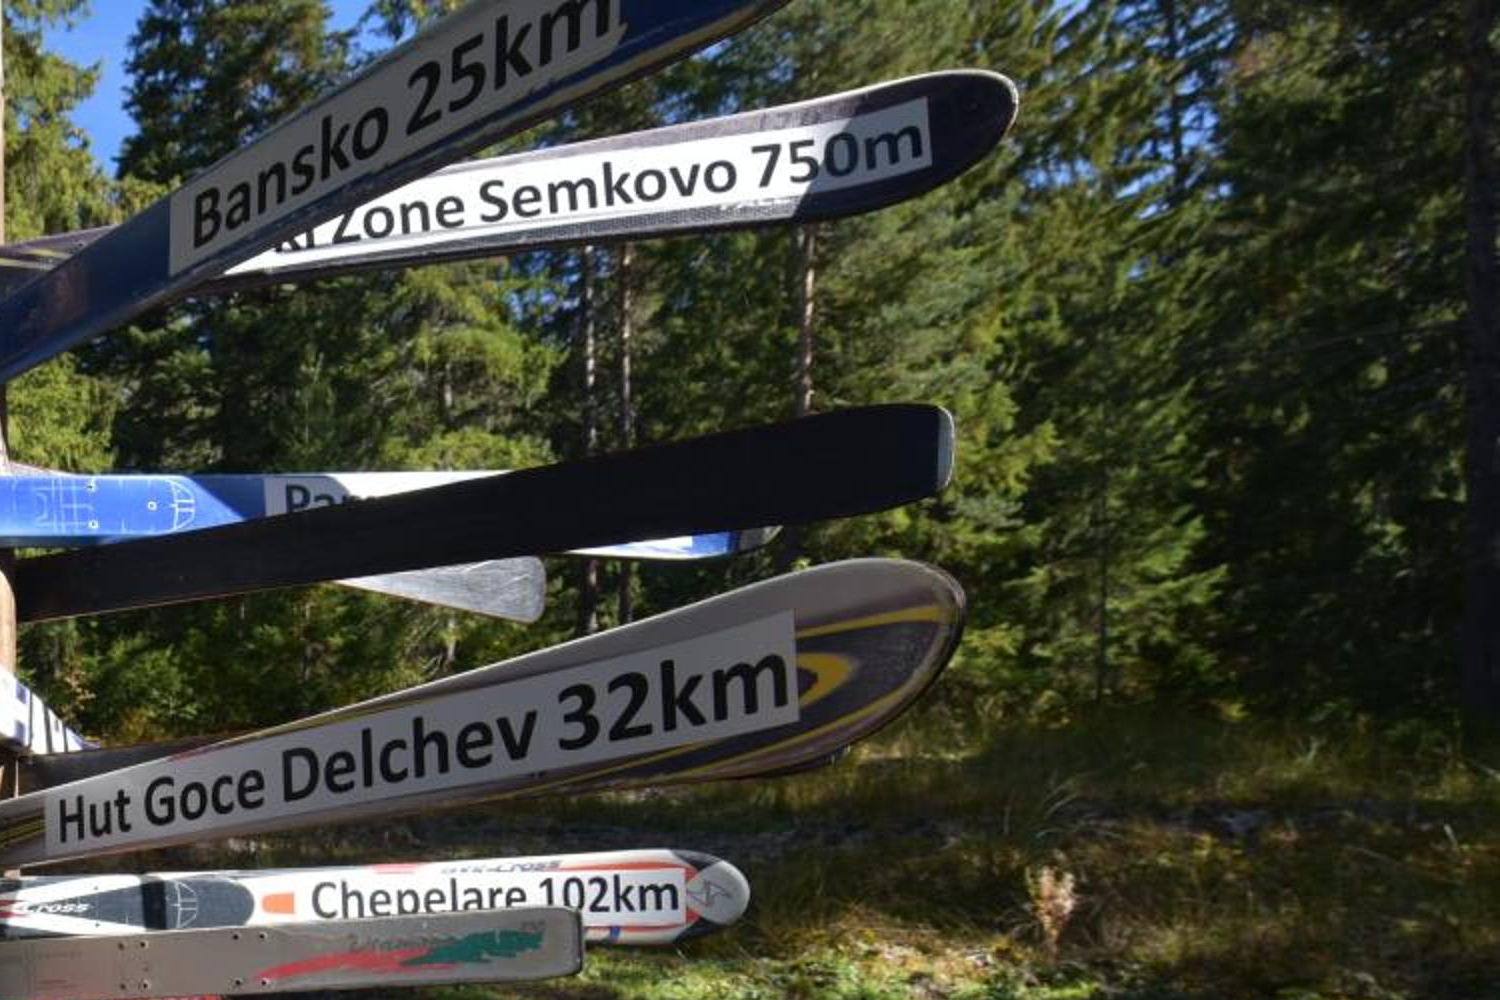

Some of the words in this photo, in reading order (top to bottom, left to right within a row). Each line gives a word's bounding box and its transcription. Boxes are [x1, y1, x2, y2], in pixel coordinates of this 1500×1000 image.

[193, 107, 390, 249] Bansko
[406, 0, 612, 136] 25km
[332, 195, 465, 245] Zone
[478, 158, 737, 224] Semkovo
[751, 123, 923, 188] 750m
[58, 793, 132, 845] Hut
[144, 766, 266, 826] Goce
[281, 711, 537, 800] Delchev
[557, 651, 791, 752] 32km
[311, 878, 527, 918] Chepelare
[538, 873, 680, 914] 102km
